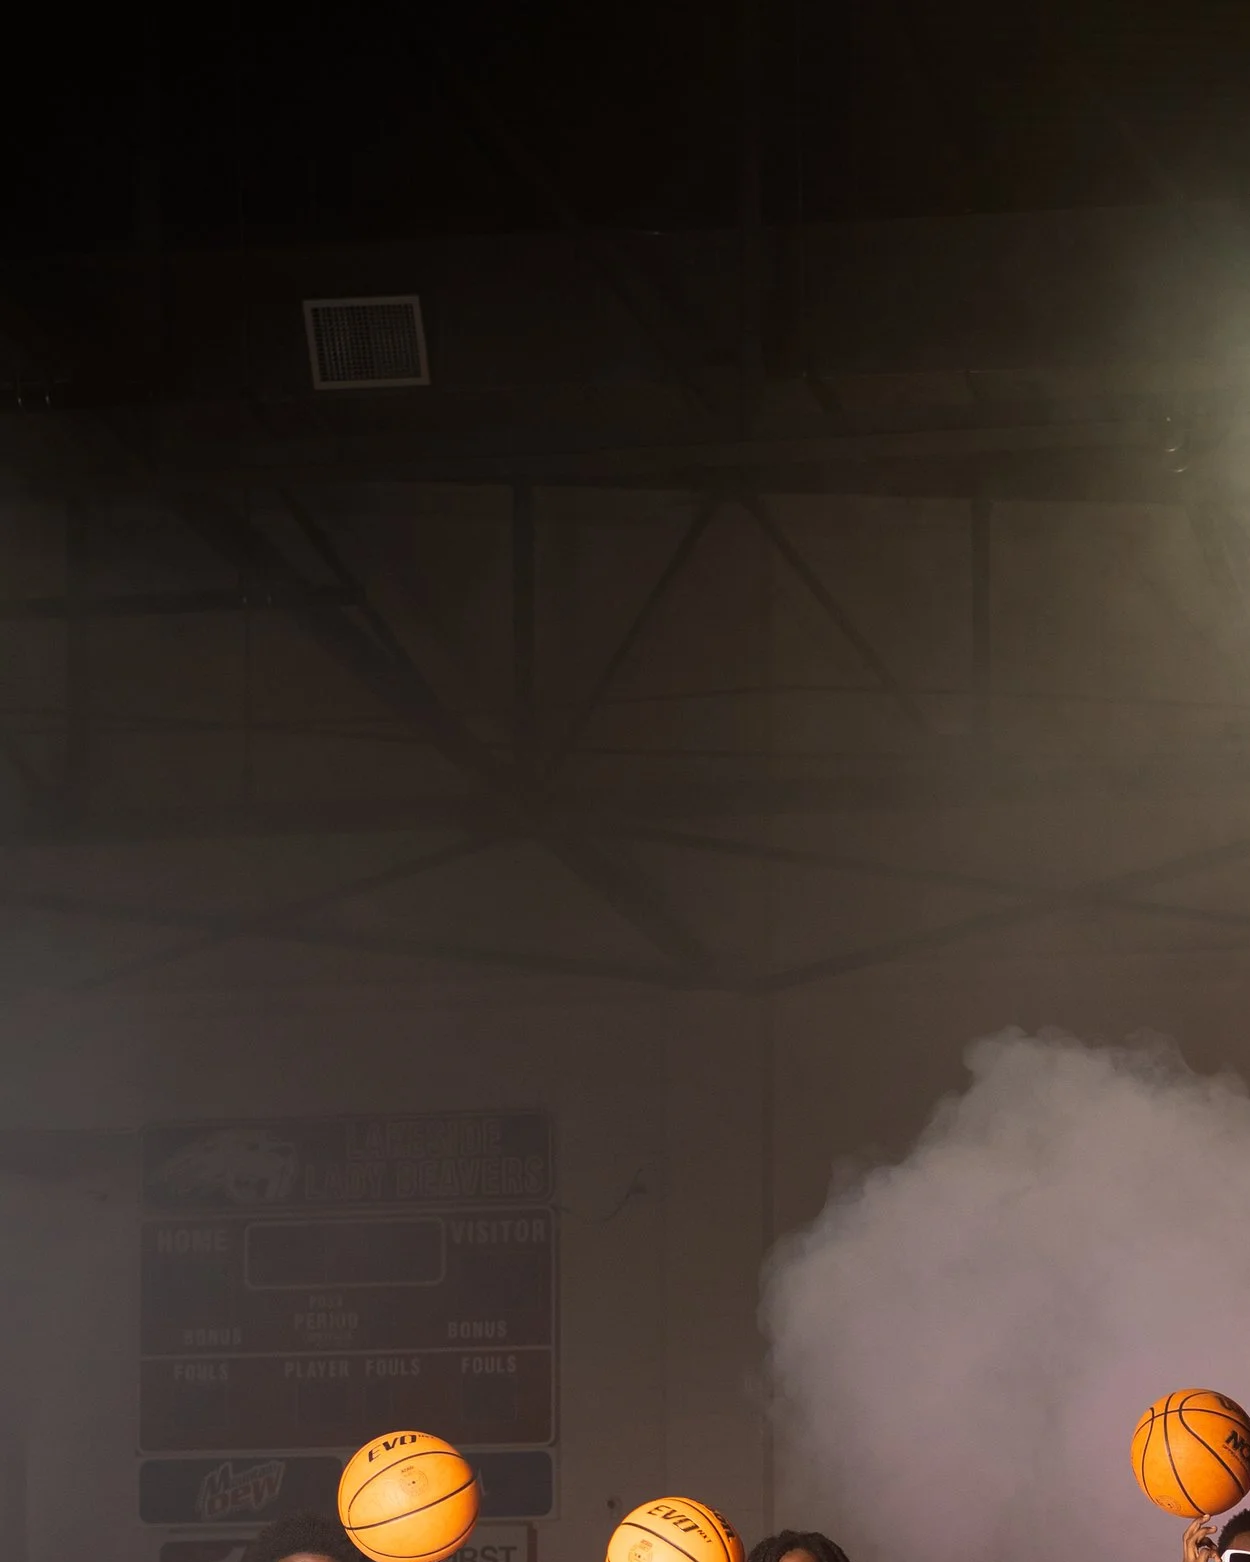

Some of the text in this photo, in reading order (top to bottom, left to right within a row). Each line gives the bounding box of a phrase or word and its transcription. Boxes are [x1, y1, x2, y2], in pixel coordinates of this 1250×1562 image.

[346, 1117, 502, 1159] LAKESIDE
[305, 1155, 545, 1200] LADY BEAVERS
[157, 1228, 228, 1253] HOME
[450, 1218, 546, 1244] VISITOR
[294, 1312, 358, 1331] PERIOD
[447, 1320, 508, 1339] BONUS
[183, 1328, 242, 1347] BONUS
[173, 1363, 230, 1381] FOULS
[284, 1357, 421, 1379] PLAYER FOULS
[461, 1354, 518, 1375] FOULS
[368, 1434, 417, 1462] EVO
[647, 1504, 699, 1533] EVO
